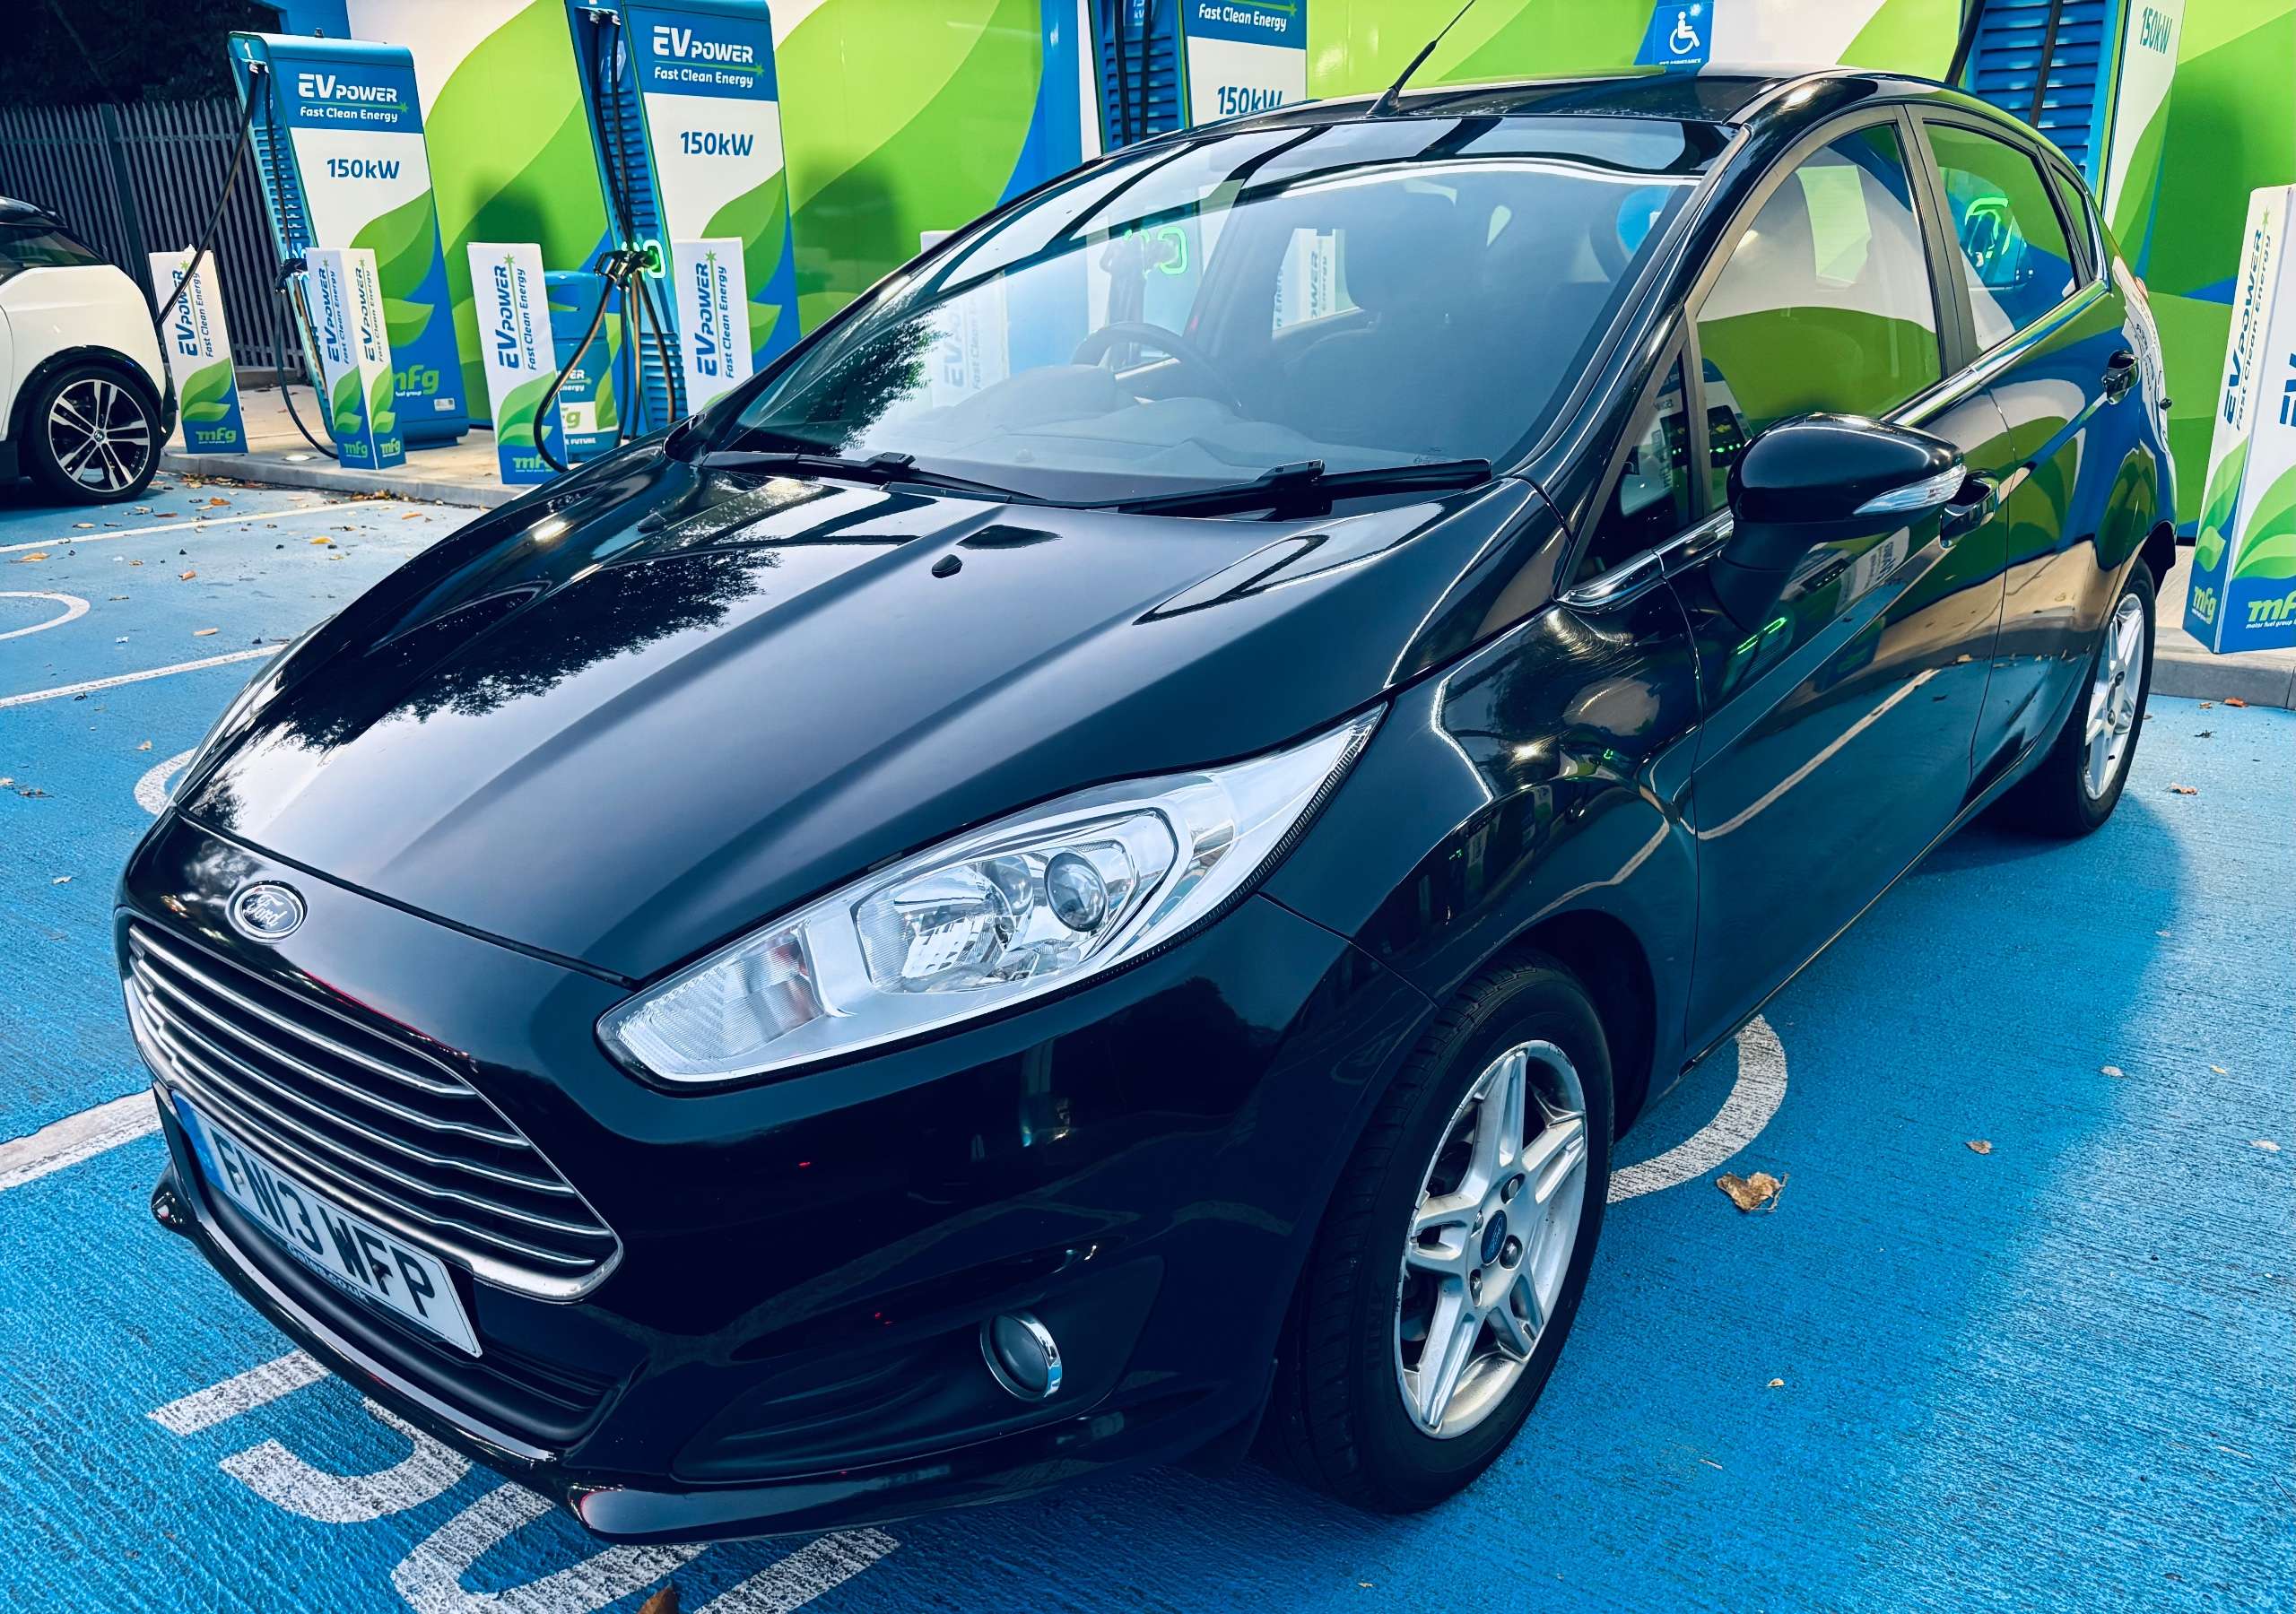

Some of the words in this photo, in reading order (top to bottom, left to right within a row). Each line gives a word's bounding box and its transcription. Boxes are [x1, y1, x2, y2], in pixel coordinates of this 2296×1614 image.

[1198, 4, 1221, 21] Fast
[1222, 7, 1251, 25] Clean
[1253, 11, 1287, 32] Energy
[2140, 6, 2172, 55] 150kW
[654, 66, 679, 81] Fast
[681, 68, 712, 83] Clean
[716, 72, 753, 89] Energy
[300, 106, 324, 118] Fast
[326, 107, 358, 119] Clean
[360, 108, 398, 123] Energy
[1217, 85, 1283, 115] 150kW
[680, 132, 754, 157] 150kW
[326, 158, 400, 179] 150kW
[193, 273, 204, 306] Energy
[517, 268, 528, 309] Energy
[718, 265, 728, 311] Energy
[199, 308, 209, 336] Clean
[523, 312, 533, 344] Clean
[722, 314, 732, 351] Clean
[2236, 386, 2247, 431] Fast
[2244, 319, 2257, 381] Clean
[2255, 235, 2271, 313] Energy
[204, 338, 214, 358] Fast
[527, 346, 537, 370] Fast
[725, 352, 735, 378] Fast
[196, 427, 237, 443] mfg
[344, 440, 368, 457] mfg
[2193, 586, 2217, 625] mfg
[2248, 589, 2296, 622] mf
[243, 894, 288, 927] Ford
[209, 1127, 324, 1255] FN13
[317, 1204, 436, 1319] WFP
